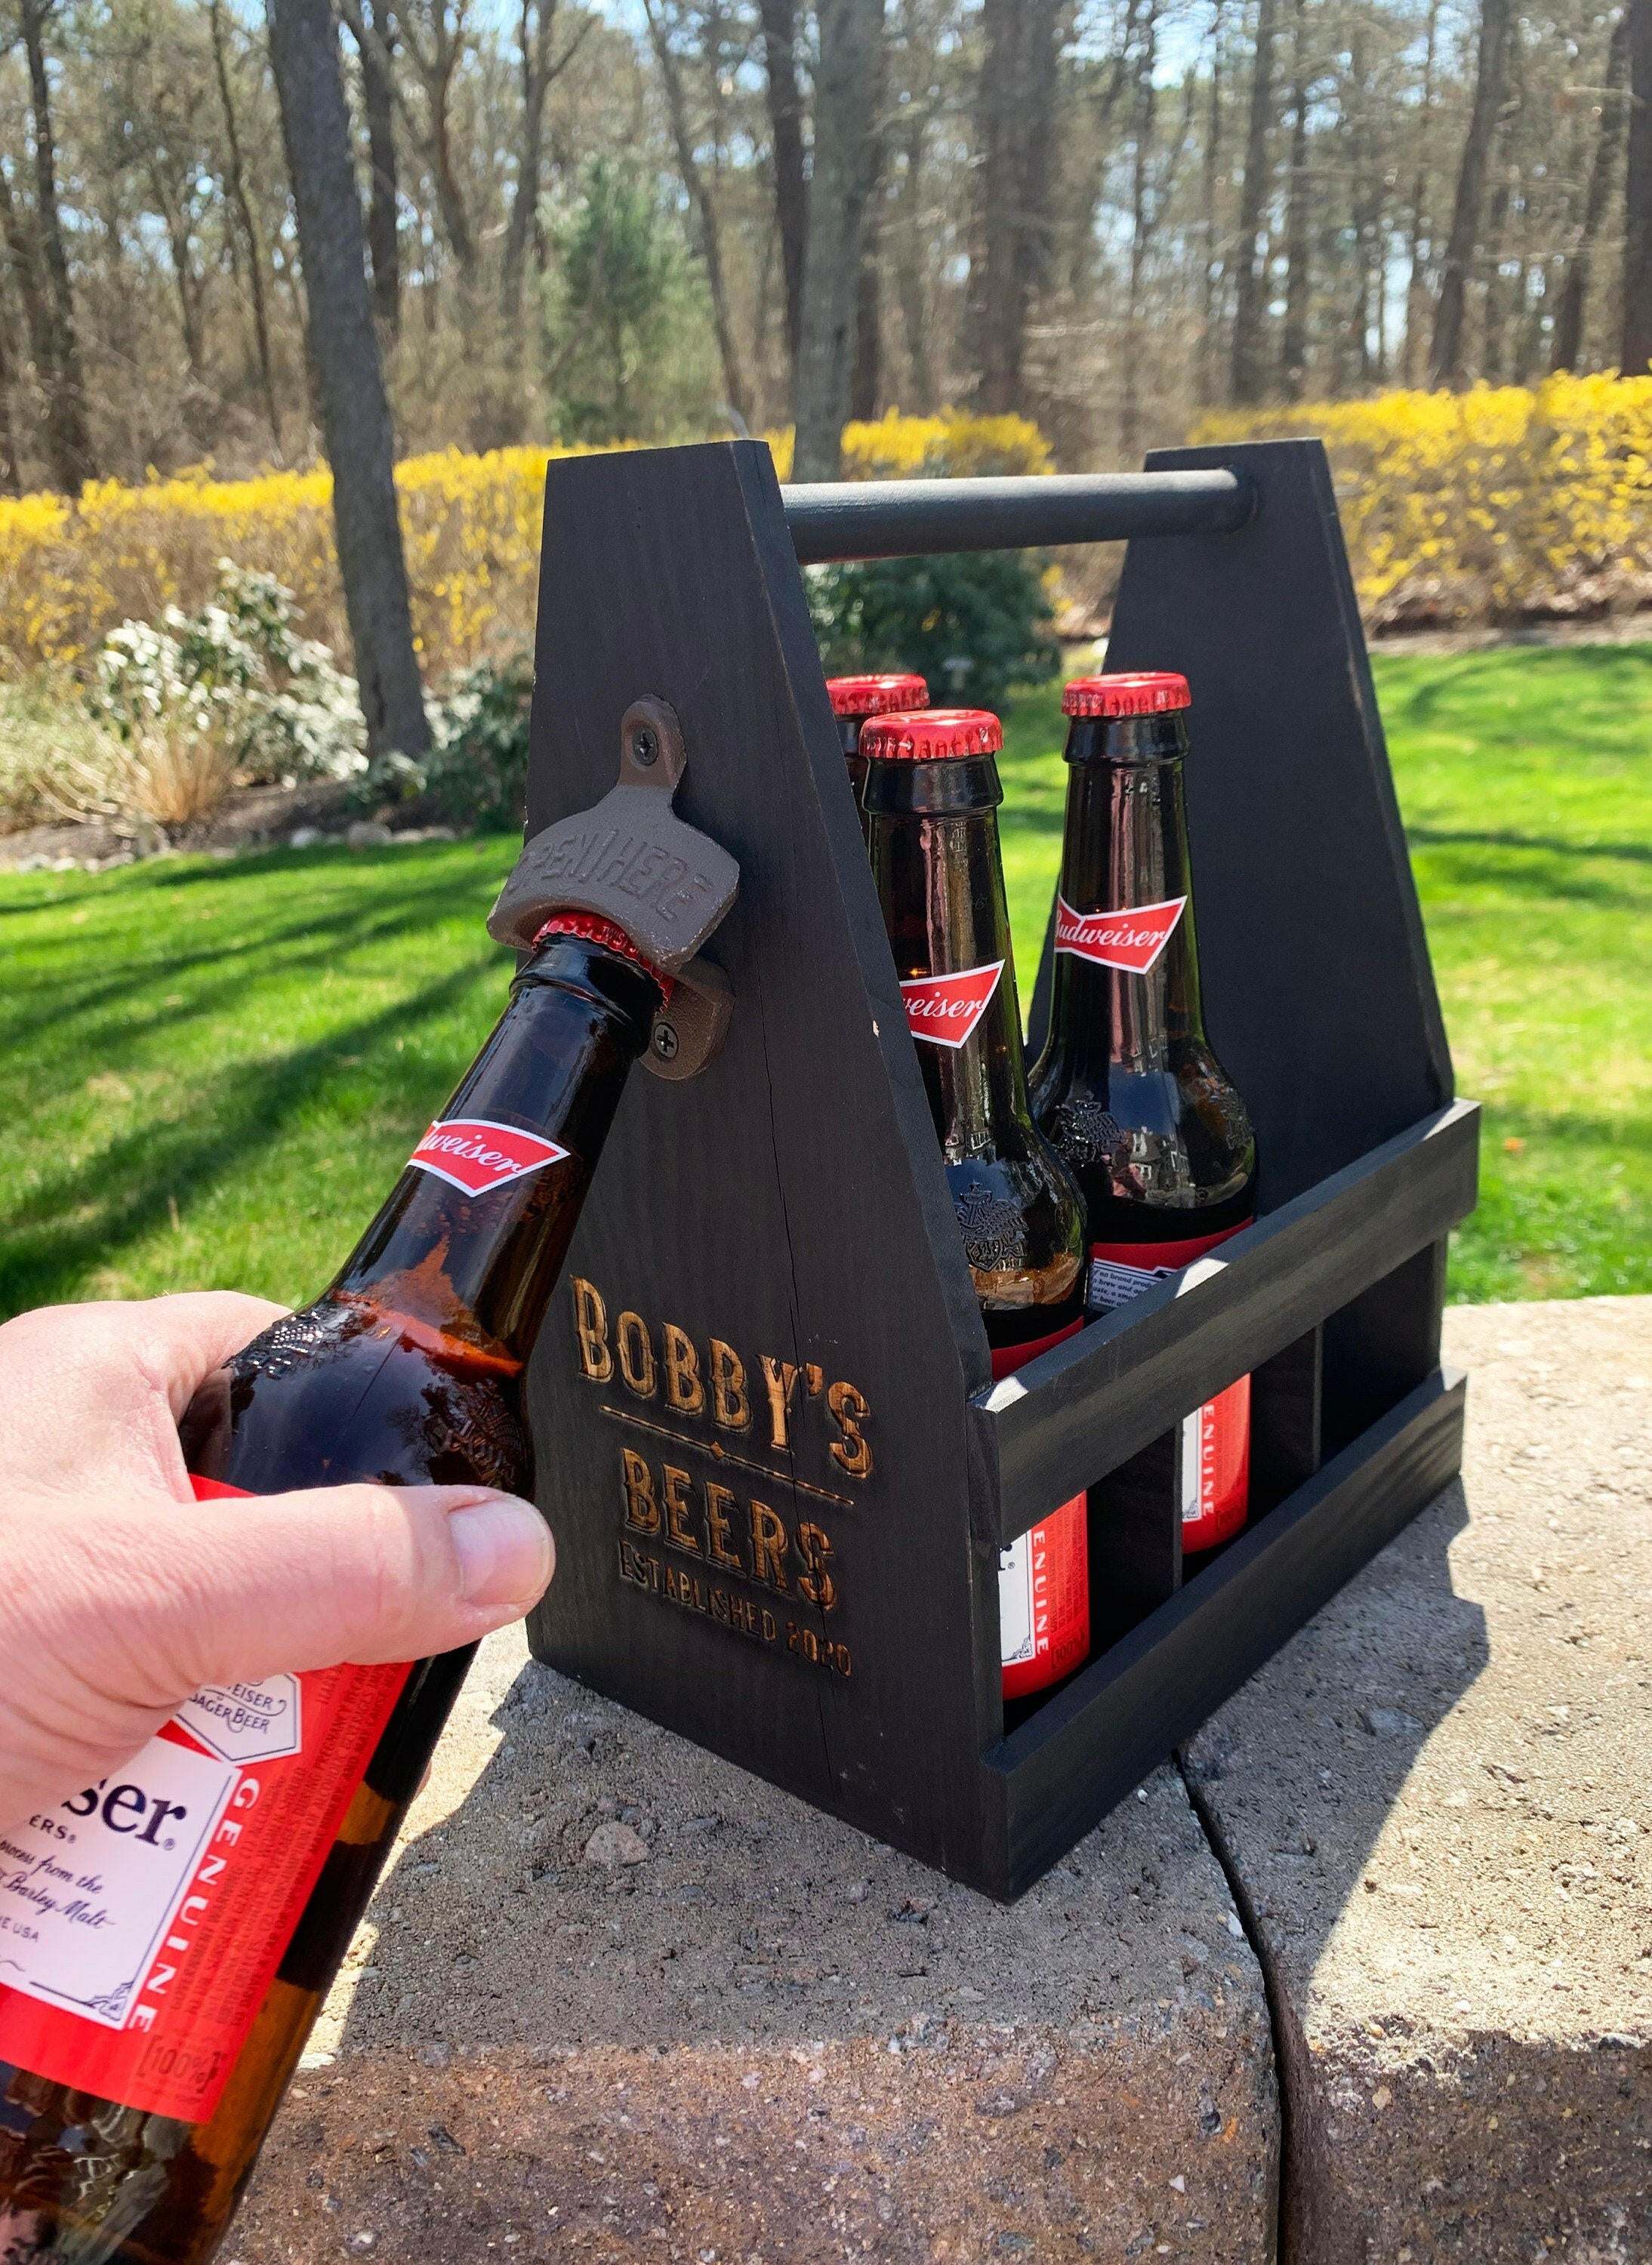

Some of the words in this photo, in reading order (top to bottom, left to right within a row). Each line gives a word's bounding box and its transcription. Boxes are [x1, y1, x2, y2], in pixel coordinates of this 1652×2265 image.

[570, 1274, 873, 1480] BOBBY'S
[1202, 1405, 1215, 1516] ENUINE
[621, 1447, 838, 1611] BEERS
[619, 1539, 777, 1643] ESTABLISHED
[787, 1621, 852, 1678] 2020
[1034, 1530, 1049, 1655] ENUINE
[228, 1684, 273, 1711] EISER
[2, 1871, 57, 1915] Barley
[13, 1923, 40, 1943] USA
[30, 1855, 74, 1882] from
[76, 1875, 103, 1894] the
[128, 1776, 262, 2033] GENUINE
